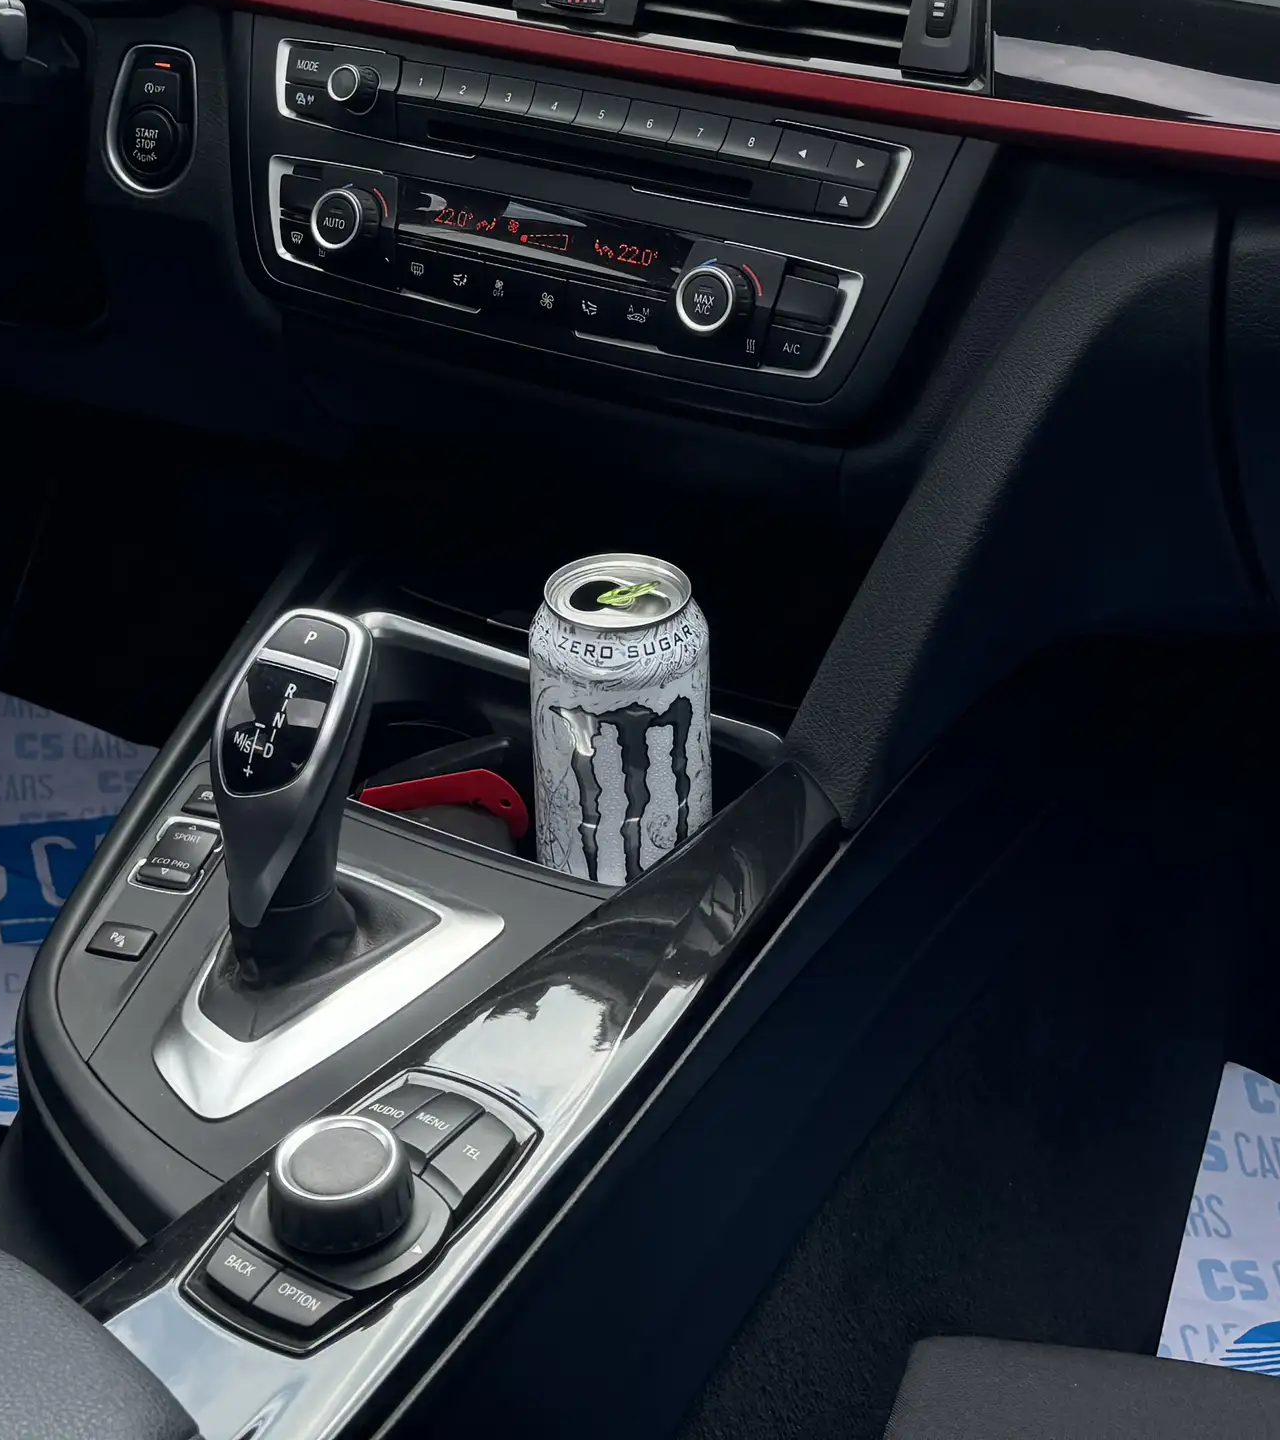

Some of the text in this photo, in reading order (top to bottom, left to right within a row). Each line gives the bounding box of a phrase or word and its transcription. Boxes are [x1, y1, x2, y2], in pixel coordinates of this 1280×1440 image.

[296, 59, 320, 73] MODE
[418, 77, 424, 87] 1
[459, 85, 467, 96] 2
[504, 92, 512, 103] 3
[550, 100, 558, 112] 4
[597, 109, 606, 120] 5
[646, 118, 654, 130] 6
[135, 127, 159, 139] START
[696, 127, 705, 139] 7
[135, 138, 156, 150] STOP
[747, 136, 756, 148] 8
[323, 216, 346, 230] AUTO
[693, 293, 715, 306] MAX
[628, 304, 650, 317] A M
[694, 303, 711, 315] A/C
[782, 342, 801, 355] A/C
[303, 630, 318, 645] P
[557, 623, 693, 660] ZERO SUGAR
[284, 683, 297, 699] R
[272, 711, 286, 729] N
[13, 732, 64, 761] CS
[233, 730, 252, 754] M/S
[262, 743, 275, 759] D
[172, 832, 202, 844] SPORT
[150, 856, 191, 870] ECO PRO
[368, 1101, 406, 1120] AUDIO
[415, 1111, 451, 1132] MENU
[461, 1143, 481, 1161] TEL
[223, 1253, 257, 1277] BACK
[1196, 1258, 1269, 1302] CS
[277, 1282, 322, 1312] OPTION
